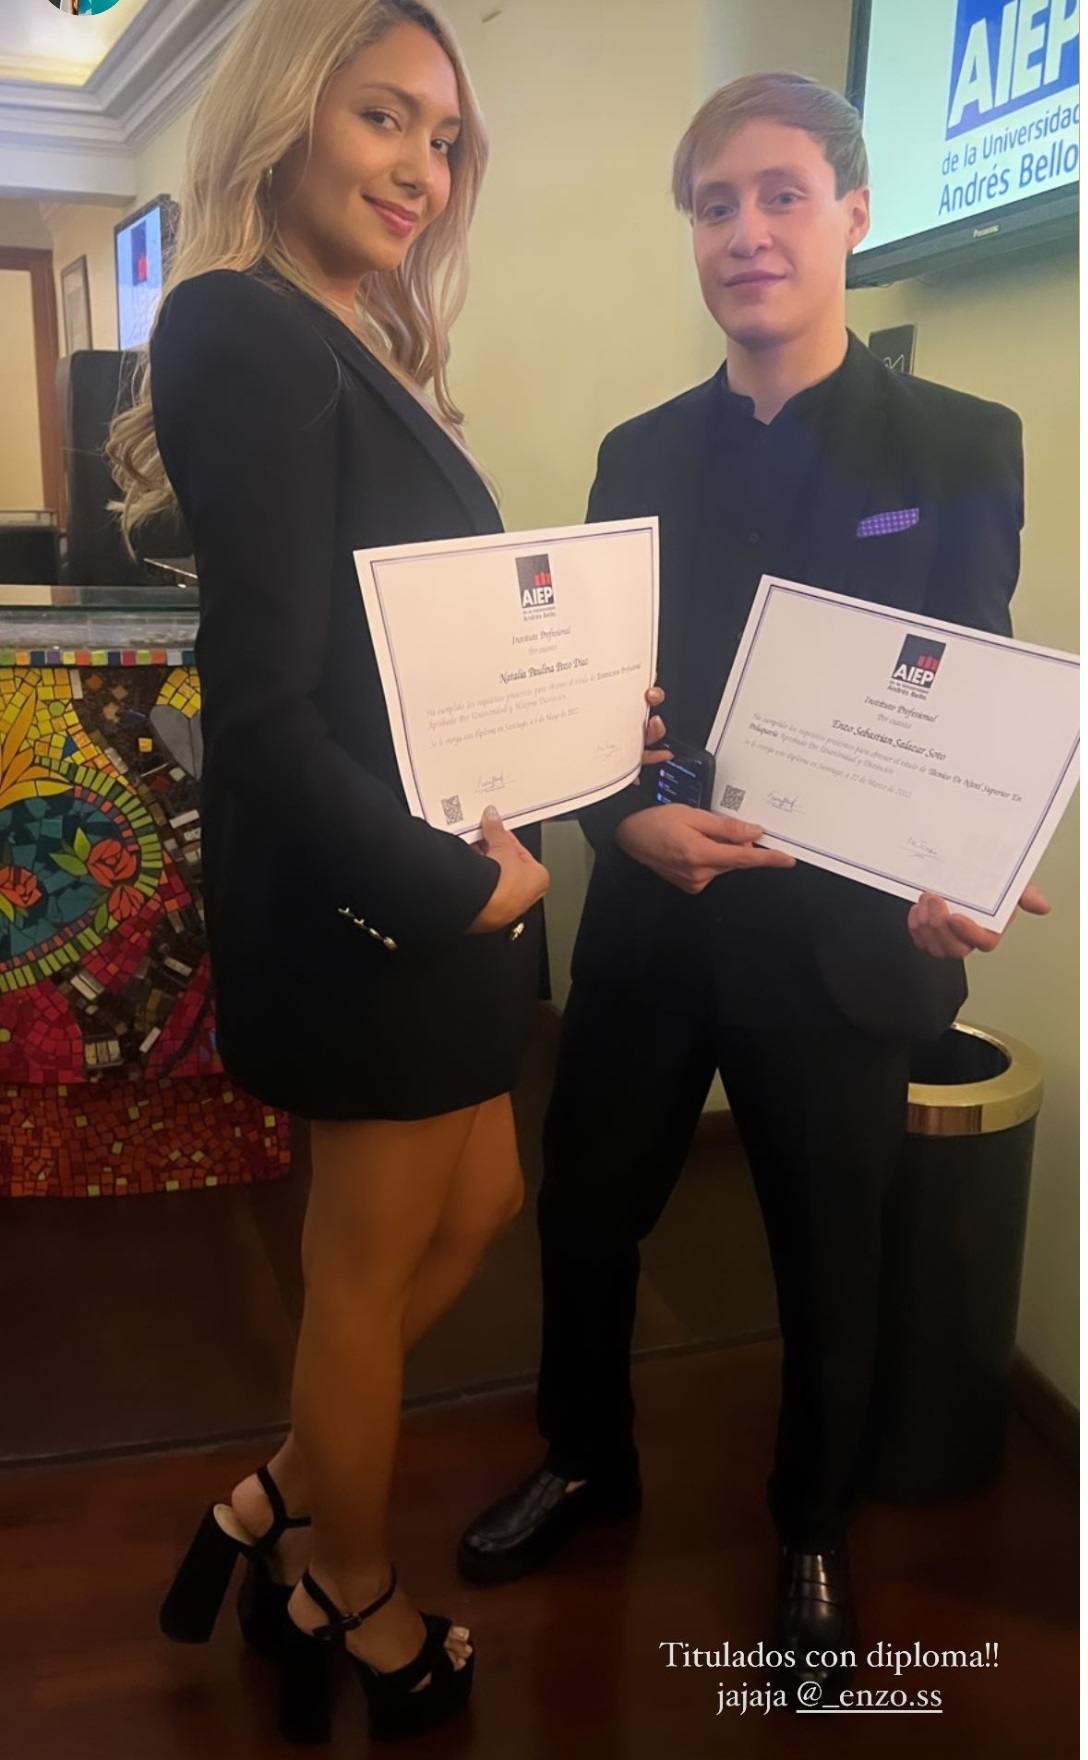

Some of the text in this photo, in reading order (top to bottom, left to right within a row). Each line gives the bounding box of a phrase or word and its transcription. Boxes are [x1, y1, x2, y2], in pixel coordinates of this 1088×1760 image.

[947, 0, 1079, 129] AIEP
[938, 139, 1079, 216] Andrés Bello
[942, 151, 959, 176] de
[964, 143, 977, 167] la
[522, 587, 552, 607] AIEP
[893, 663, 935, 685] AIEP
[832, 719, 853, 733] Enzo
[893, 738, 926, 755] Salazar
[925, 748, 946, 761] Soto
